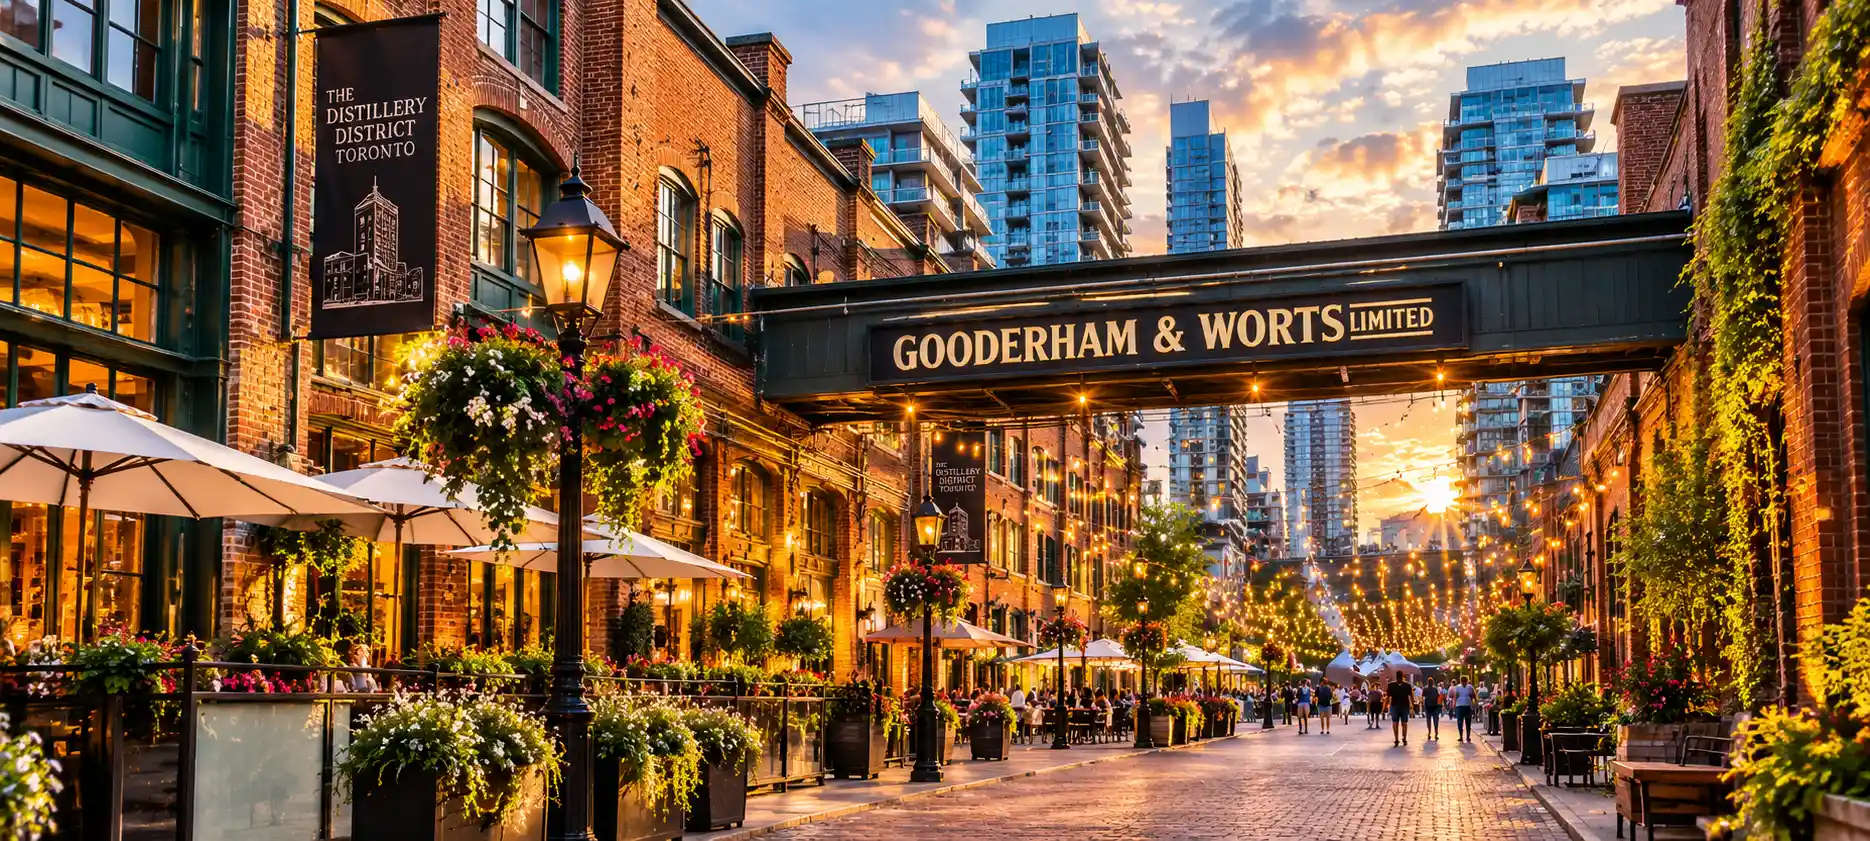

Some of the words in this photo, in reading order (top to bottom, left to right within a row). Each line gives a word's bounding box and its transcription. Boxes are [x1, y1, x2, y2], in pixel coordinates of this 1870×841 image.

[326, 87, 355, 104] THE
[326, 97, 428, 125] DISTILLERY
[335, 119, 417, 145] DISTRICT
[335, 140, 416, 164] TORONTO
[893, 318, 1138, 371] GOODERHAM
[1153, 315, 1187, 353] &
[1197, 303, 1345, 350] WORTS
[1349, 306, 1434, 333] LIMITED
